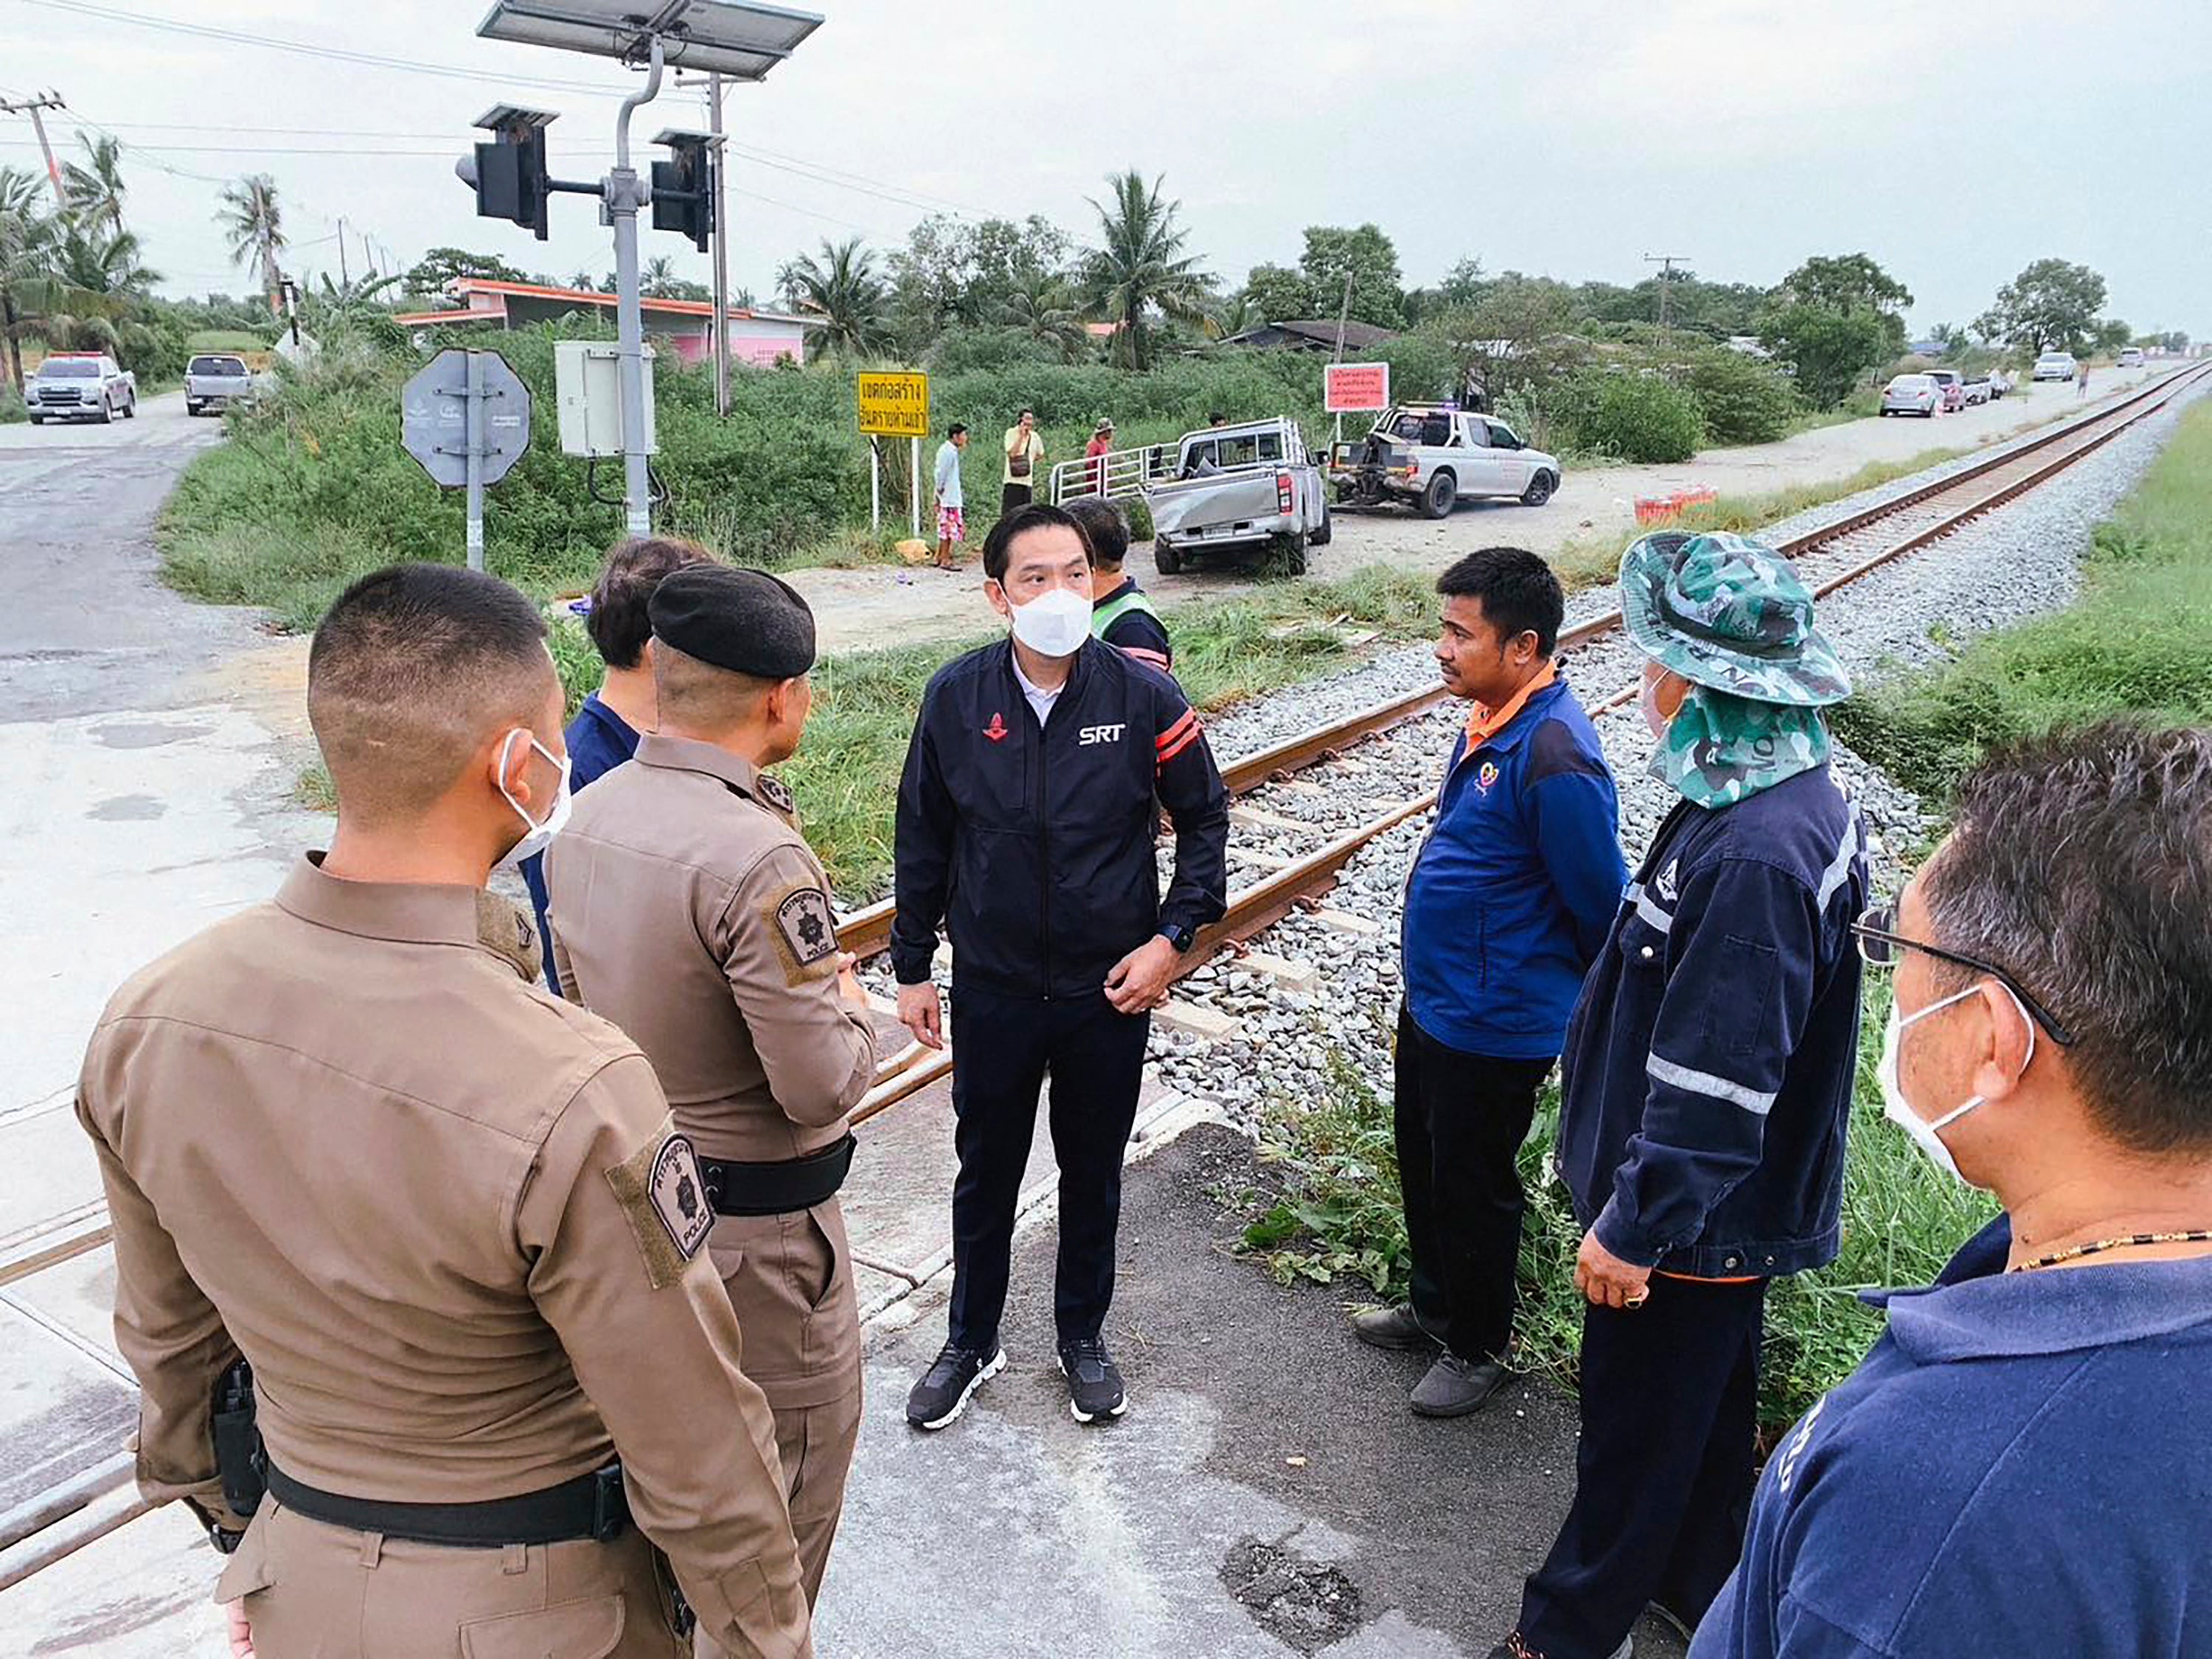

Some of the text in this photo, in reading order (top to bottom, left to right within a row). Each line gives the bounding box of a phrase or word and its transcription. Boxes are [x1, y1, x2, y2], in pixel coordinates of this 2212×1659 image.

[862, 376, 921, 400] เขตก่อสร้าง
[1079, 723, 1126, 745] SRT
